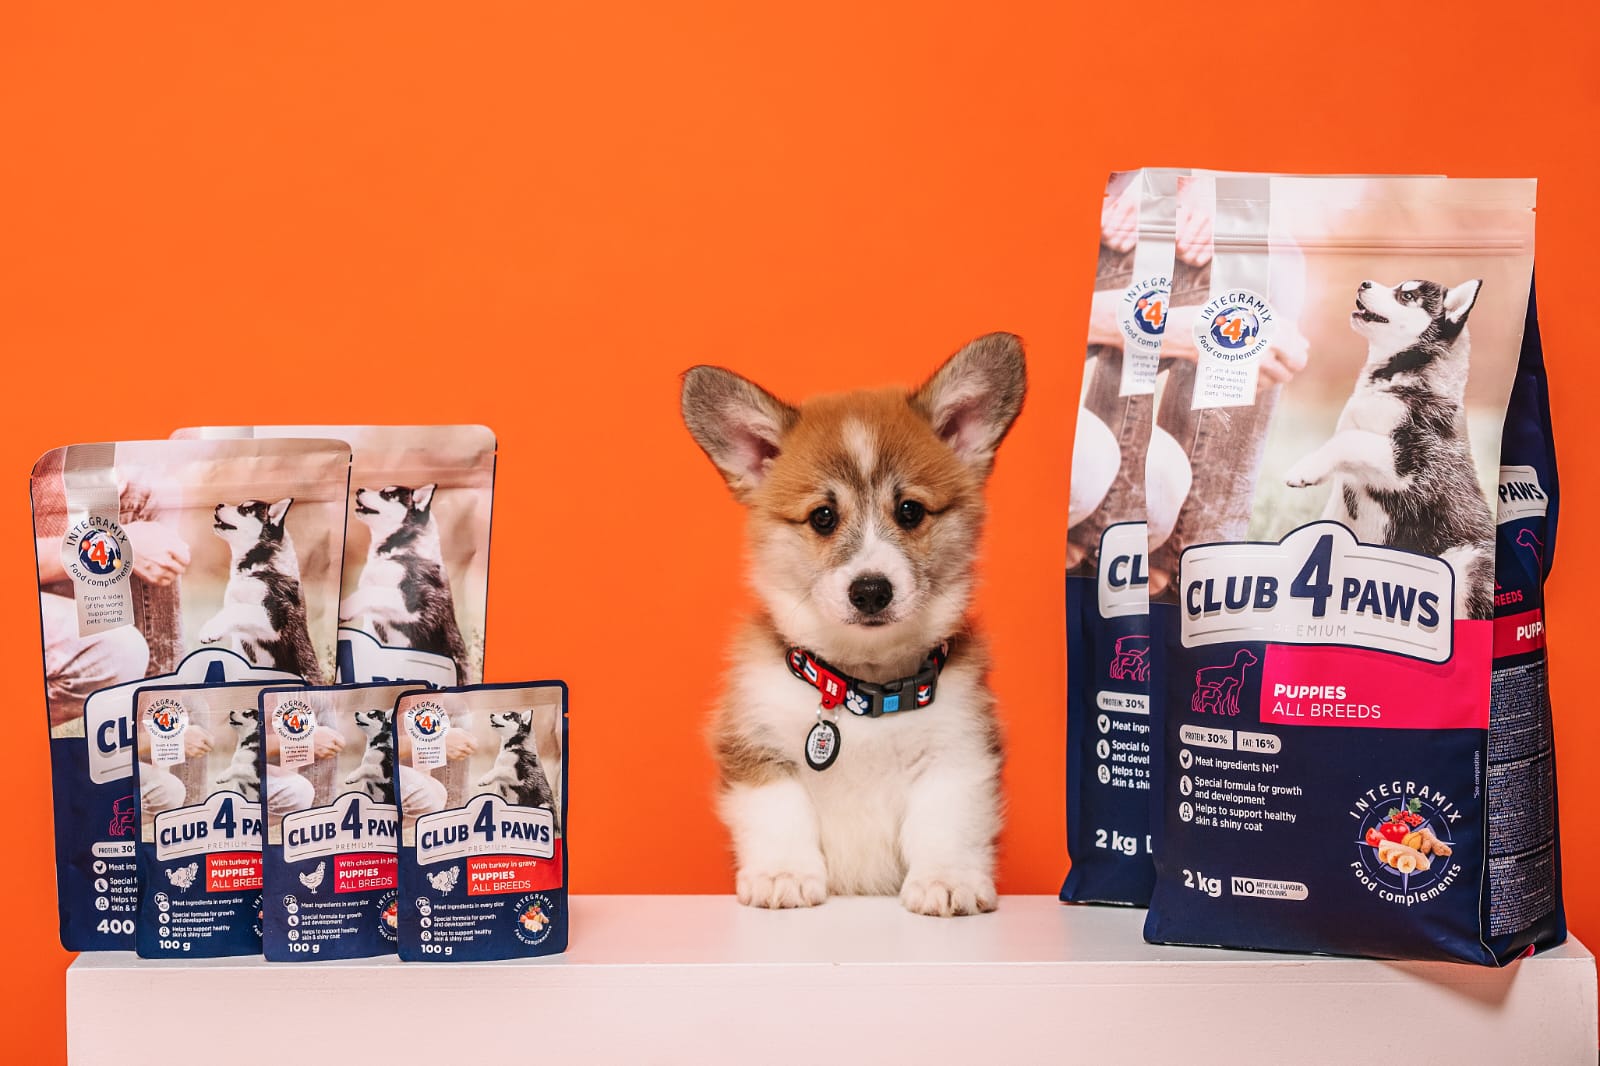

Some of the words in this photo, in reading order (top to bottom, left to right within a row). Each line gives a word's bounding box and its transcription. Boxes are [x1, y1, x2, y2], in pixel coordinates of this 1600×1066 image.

[1145, 301, 1162, 325] 4
[1201, 293, 1272, 323] INTEGRAMIX
[1124, 320, 1137, 338] Food
[1223, 318, 1241, 340] 4
[1199, 336, 1213, 352] Food
[1213, 339, 1267, 362] complements
[1498, 482, 1544, 503] PAWS
[66, 516, 127, 546] INTEGRAMIX
[91, 540, 108, 565] 4
[70, 564, 86, 580] Food
[88, 560, 130, 588] complements
[1187, 576, 1278, 616] CLUB
[1290, 535, 1333, 617] 4
[1340, 578, 1440, 628] PAWS
[1274, 684, 1346, 699] PUPPIES
[1126, 699, 1144, 709] 30%
[1272, 702, 1304, 717] ALL
[1310, 704, 1381, 719] BREEDS
[160, 712, 169, 727] 4
[291, 715, 300, 729] 4
[422, 716, 431, 729] 4
[1113, 720, 1131, 731] Meat
[1112, 740, 1139, 751] Special
[1185, 732, 1206, 741] PROTEIN:
[1208, 734, 1227, 744] 30%
[1243, 739, 1253, 747] FAT:
[1256, 739, 1274, 749] 16%
[1112, 753, 1126, 762] and
[1195, 756, 1213, 766] Meat
[1215, 758, 1260, 772] ingredients
[1112, 765, 1133, 776] Helps
[1135, 768, 1143, 776] to
[1112, 778, 1126, 787] skin
[1128, 779, 1134, 788] &
[1195, 776, 1222, 788] Special
[1224, 779, 1255, 791] formula
[1258, 782, 1270, 792] for
[1272, 786, 1302, 796] growth
[1195, 790, 1209, 799] and
[1211, 791, 1265, 805] development
[1350, 782, 1462, 823] INTEGRAMIX
[1195, 802, 1217, 814] Helps
[1219, 806, 1227, 815] to
[1229, 809, 1262, 818] support
[1264, 810, 1296, 823] healthy
[160, 821, 208, 846] CLUB
[213, 798, 236, 838] 4
[288, 822, 336, 847] CLUB
[341, 799, 363, 839] 4
[421, 825, 469, 849] CLUB
[474, 800, 496, 841] 4
[502, 821, 550, 842] PAWS
[1195, 816, 1210, 826] skin
[1212, 818, 1218, 827] &
[1220, 819, 1242, 831] shiny
[1244, 822, 1263, 832] coat
[207, 841, 248, 849] PREMIUM
[336, 842, 373, 850] PREMIUM
[1096, 829, 1107, 848] 2
[1112, 831, 1137, 855] kg
[518, 860, 536, 868] gravy
[211, 868, 255, 878] PUPPIES
[340, 868, 378, 879] PUPPIES
[472, 871, 515, 881] PUPPIES
[110, 877, 132, 885] Special
[212, 880, 230, 888] ALL
[340, 881, 356, 889] ALL
[359, 877, 392, 887] BREEDS
[472, 884, 491, 892] ALL
[493, 880, 531, 890] BREEDS
[1183, 869, 1194, 888] 2
[1197, 872, 1221, 898] kg
[1234, 880, 1254, 893] NO
[1351, 861, 1377, 891] Food
[1379, 863, 1461, 906] complements
[514, 894, 554, 912] INTEGRAMIX
[97, 919, 135, 934] 400
[159, 940, 180, 949] 100
[183, 942, 190, 951] g
[288, 943, 310, 952] 100
[312, 944, 320, 953] g
[421, 945, 442, 953] 100
[445, 946, 452, 955] g
